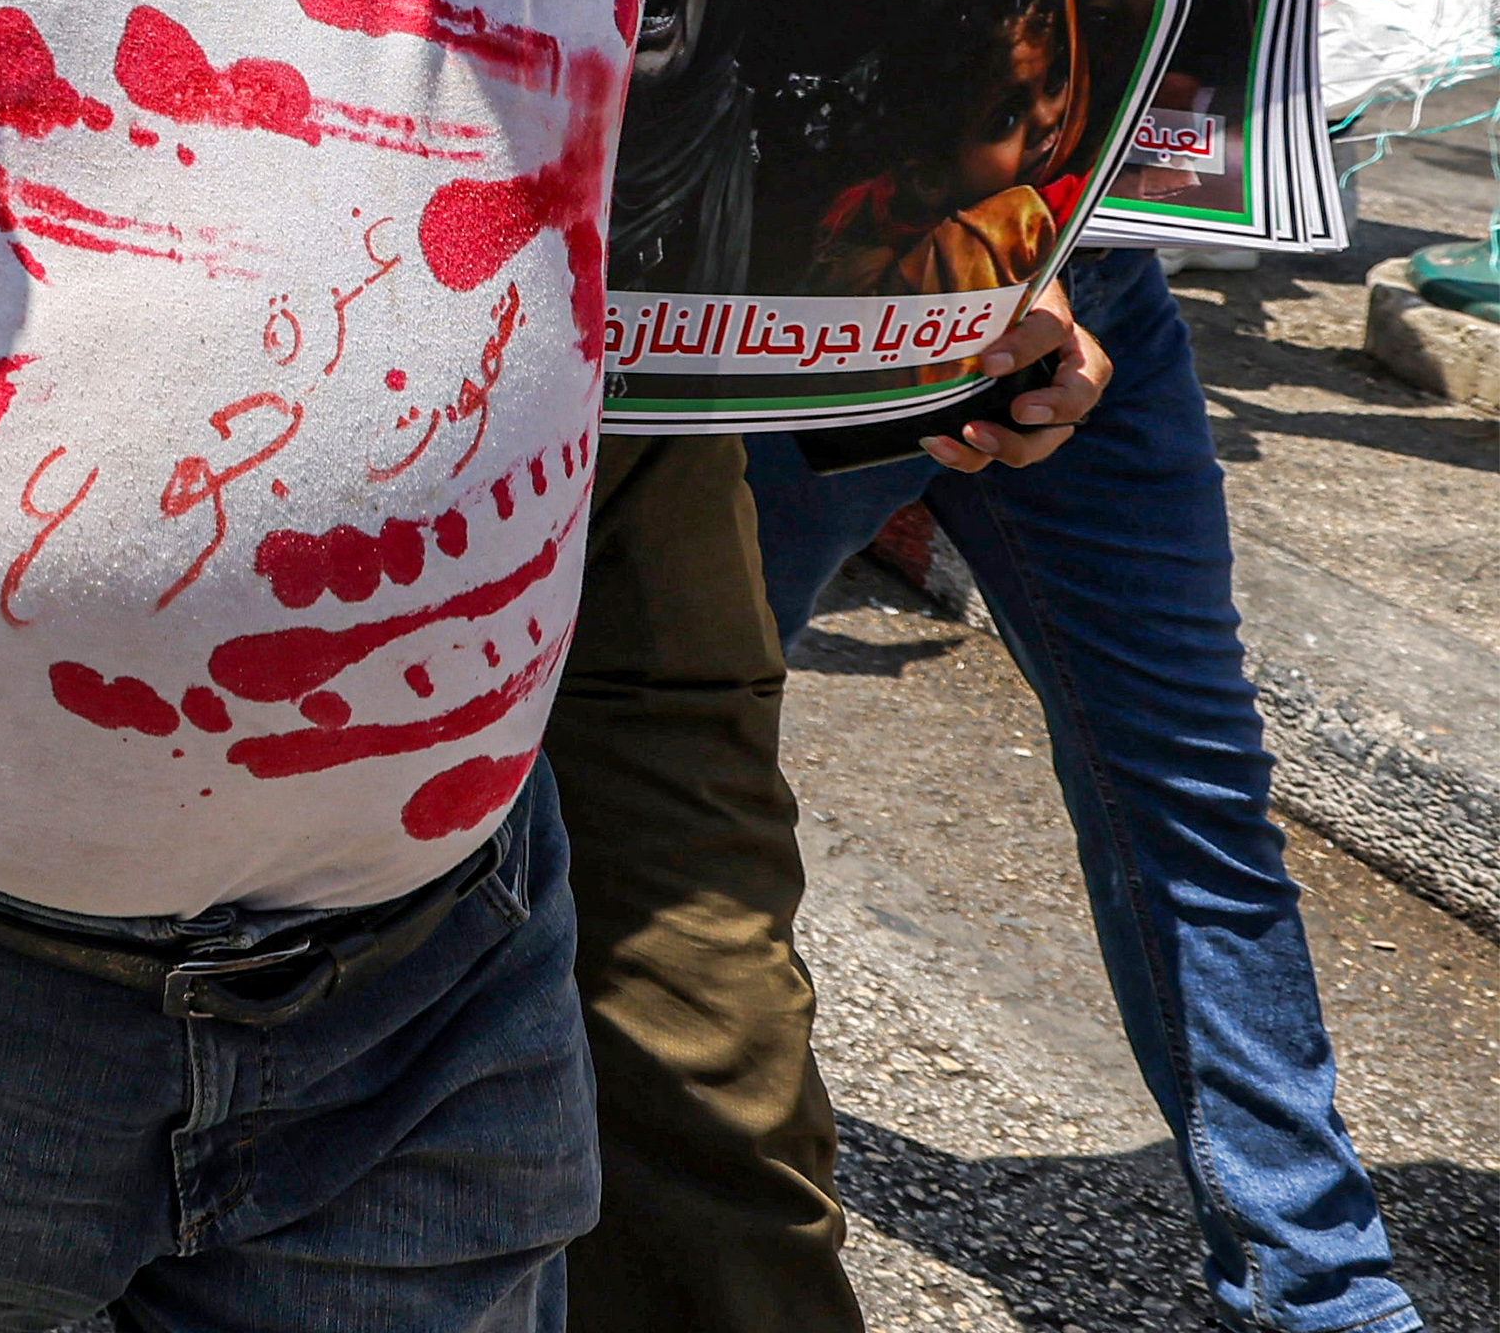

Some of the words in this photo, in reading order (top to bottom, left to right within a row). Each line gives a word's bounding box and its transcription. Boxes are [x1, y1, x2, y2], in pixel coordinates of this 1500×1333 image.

[735, 304, 862, 368] جرحنا
[873, 304, 908, 363] يا
[913, 302, 993, 358] غزة
